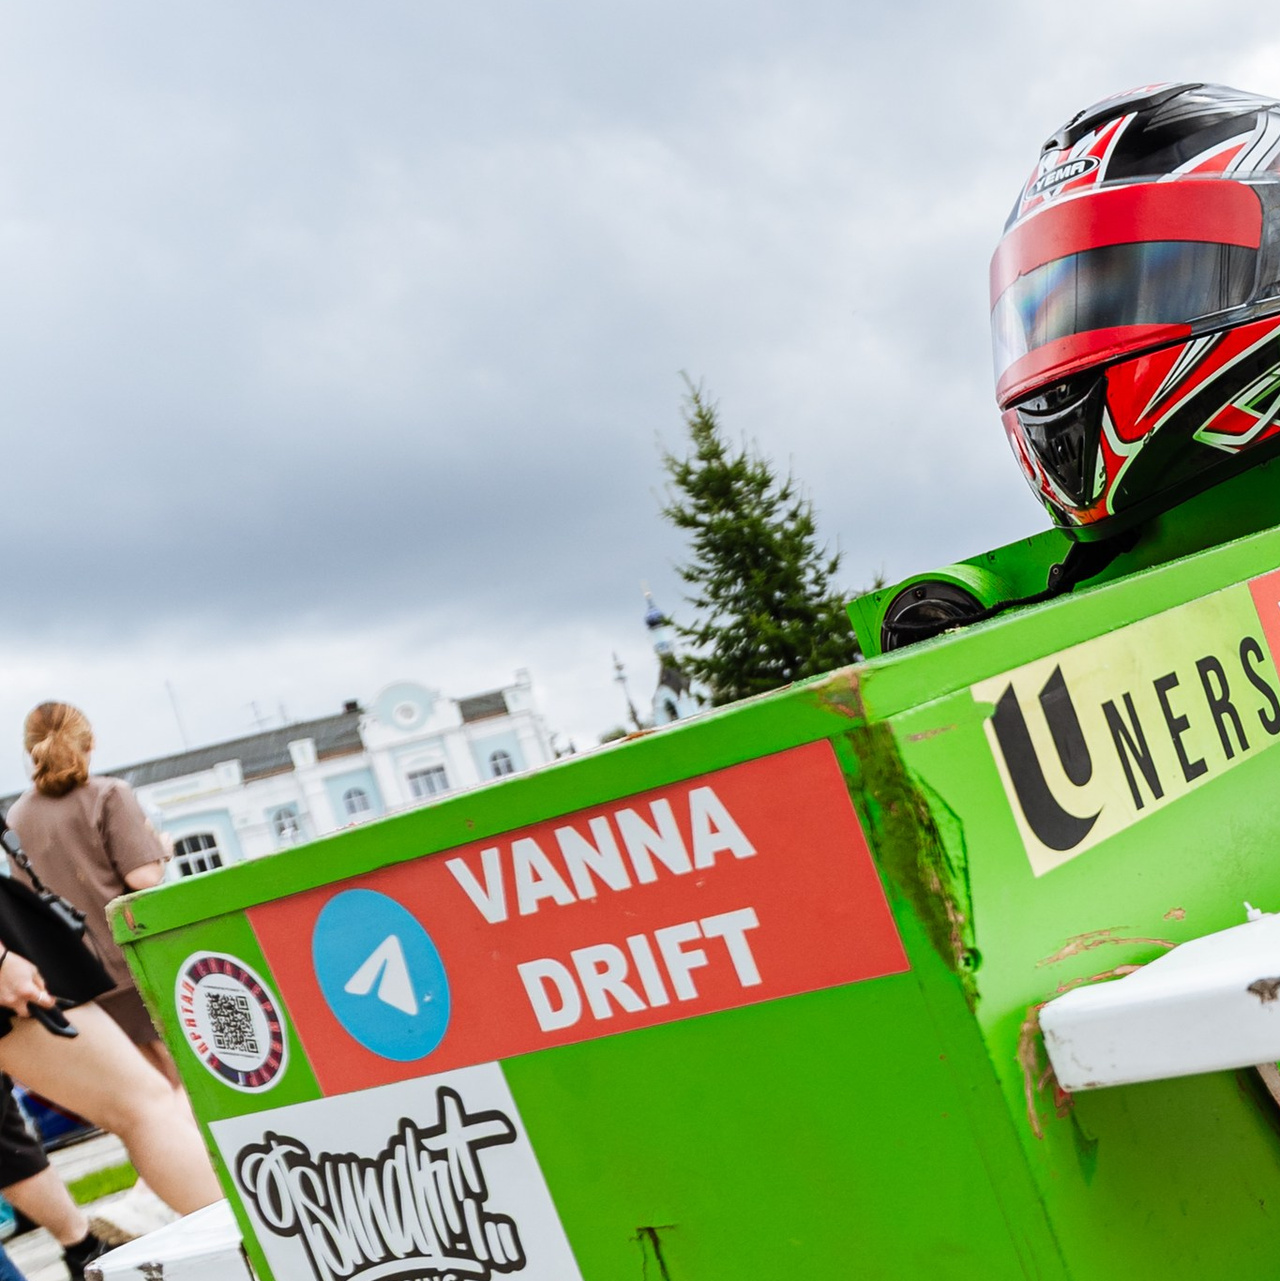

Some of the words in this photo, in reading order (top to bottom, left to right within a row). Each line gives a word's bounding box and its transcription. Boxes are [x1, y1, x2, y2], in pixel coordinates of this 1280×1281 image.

[1035, 160, 1086, 192] YEMA
[445, 785, 757, 925] VANNA
[516, 906, 763, 1033] DRIFT
